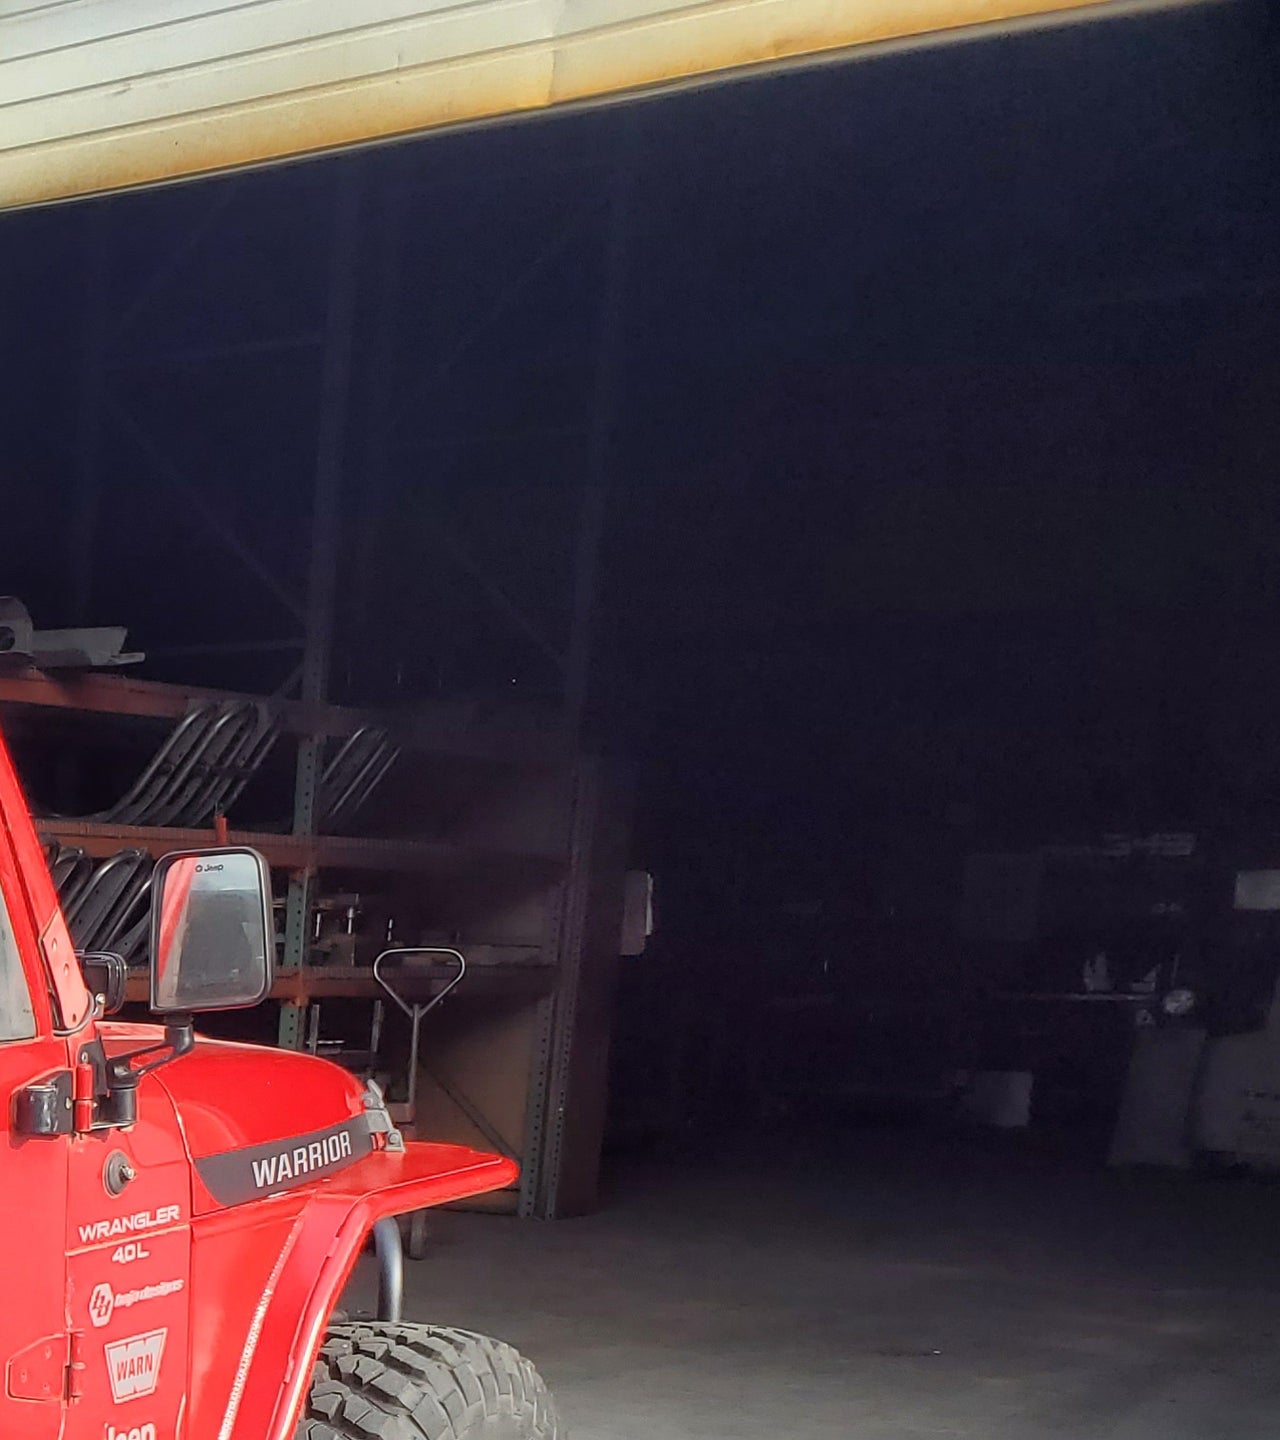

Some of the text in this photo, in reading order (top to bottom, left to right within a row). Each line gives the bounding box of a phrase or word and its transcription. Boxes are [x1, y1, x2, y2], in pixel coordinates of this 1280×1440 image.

[251, 1129, 353, 1189] WARRIOR
[78, 1204, 180, 1244] WRANGLER
[116, 1352, 154, 1382] WARN
